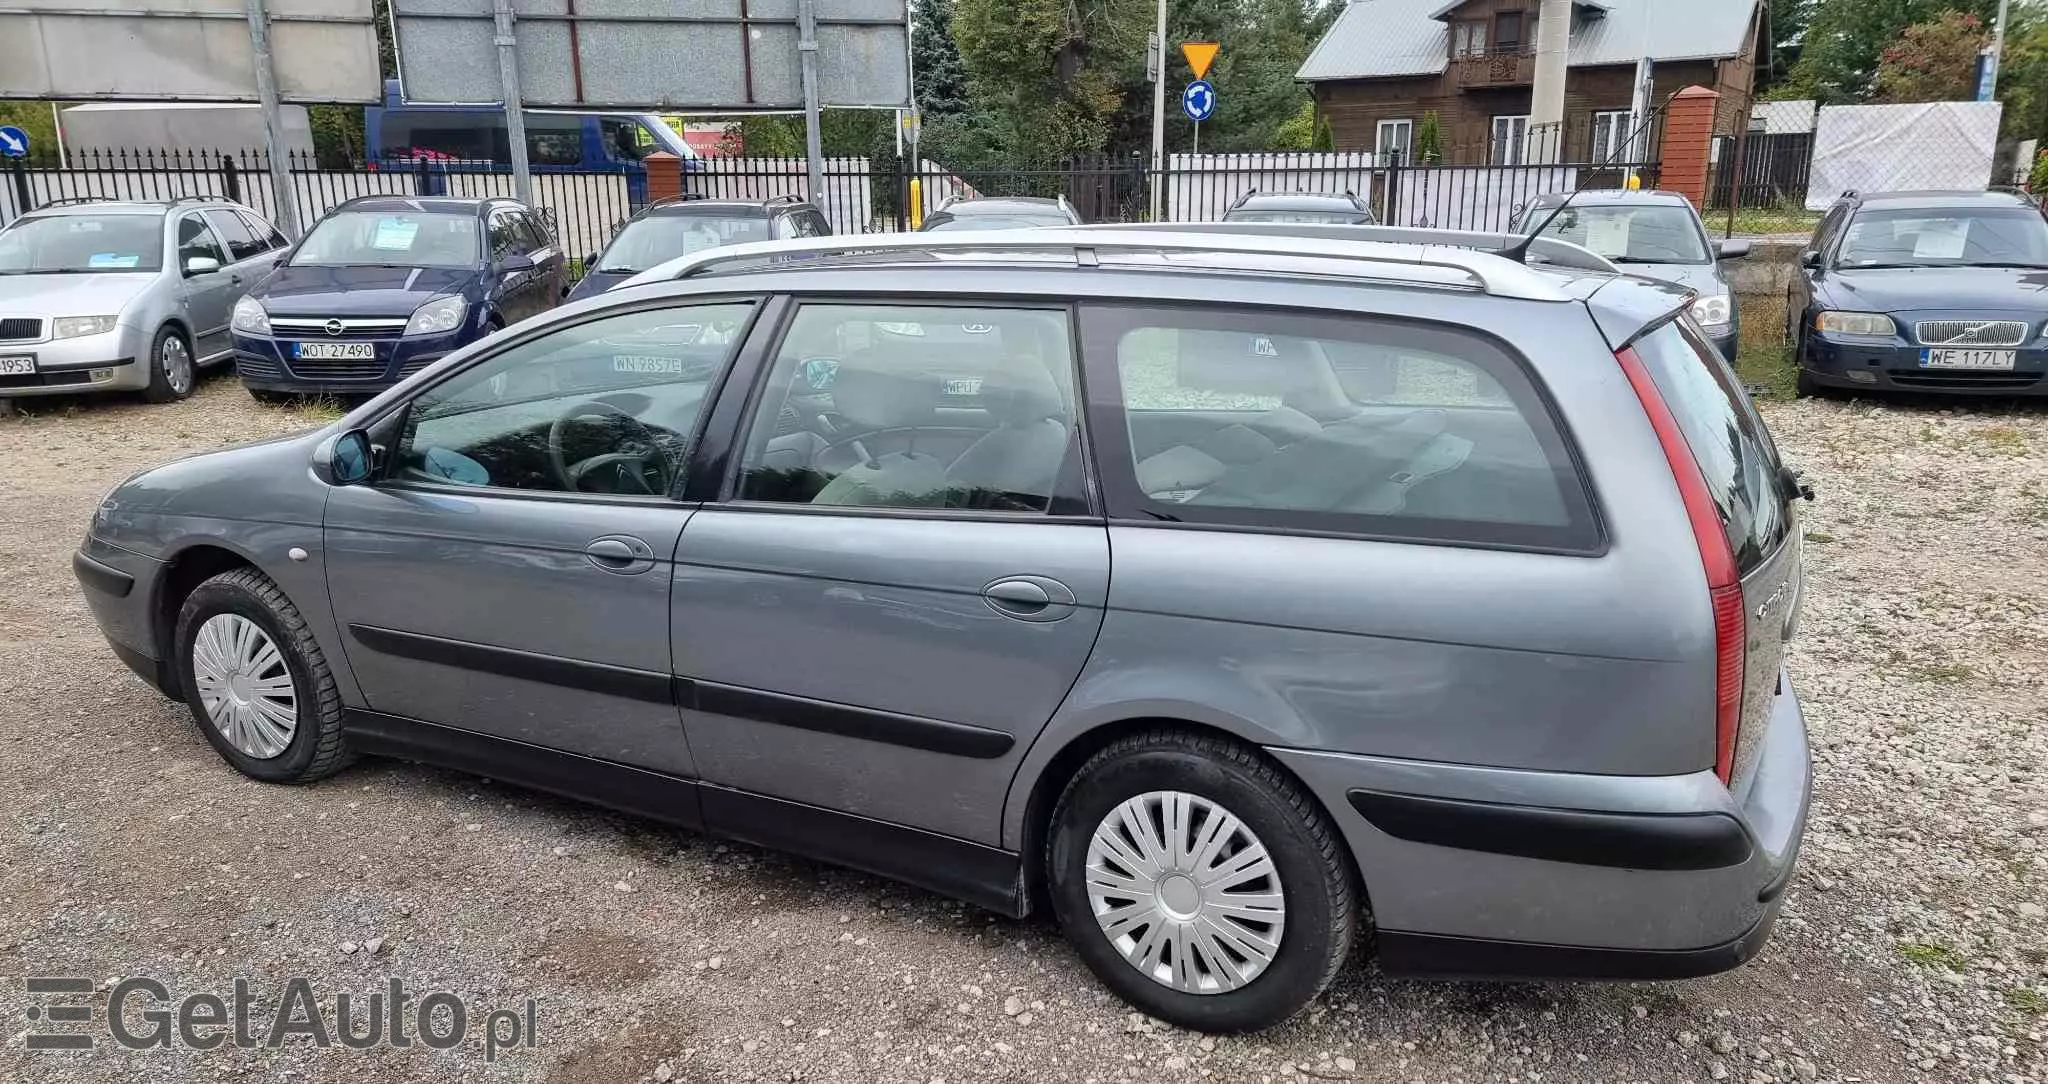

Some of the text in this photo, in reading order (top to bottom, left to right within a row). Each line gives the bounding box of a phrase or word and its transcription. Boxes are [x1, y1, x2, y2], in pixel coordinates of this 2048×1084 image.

[301, 344, 373, 357] WOT 27490
[616, 357, 635, 370] WN
[1931, 350, 2014, 365] WE 117LY
[0, 359, 33, 372] 1953
